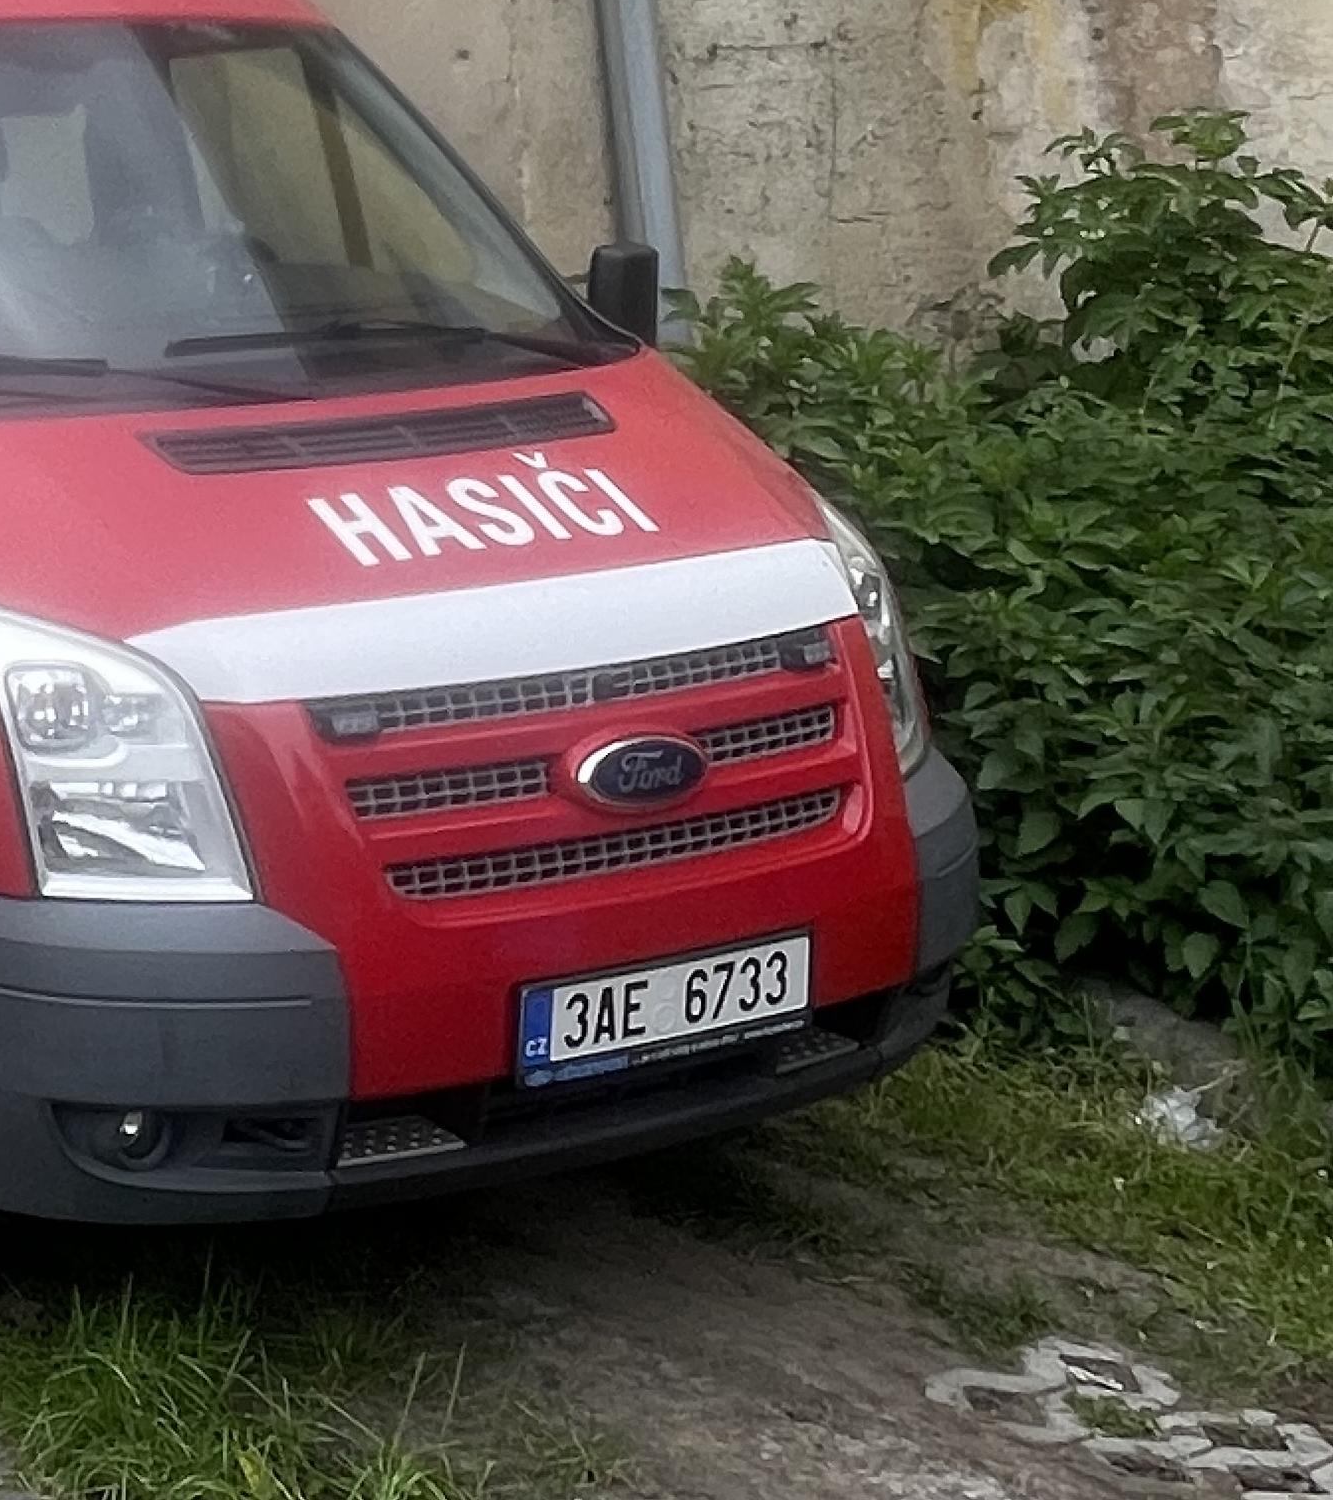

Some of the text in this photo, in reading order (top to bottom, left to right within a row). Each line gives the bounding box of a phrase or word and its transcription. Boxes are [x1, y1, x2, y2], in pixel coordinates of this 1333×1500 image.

[307, 451, 662, 567] HASIČI
[618, 749, 682, 793] Ford
[563, 979, 649, 1048] 3AE
[684, 951, 788, 1023] 6733
[525, 1037, 547, 1058] CZ
